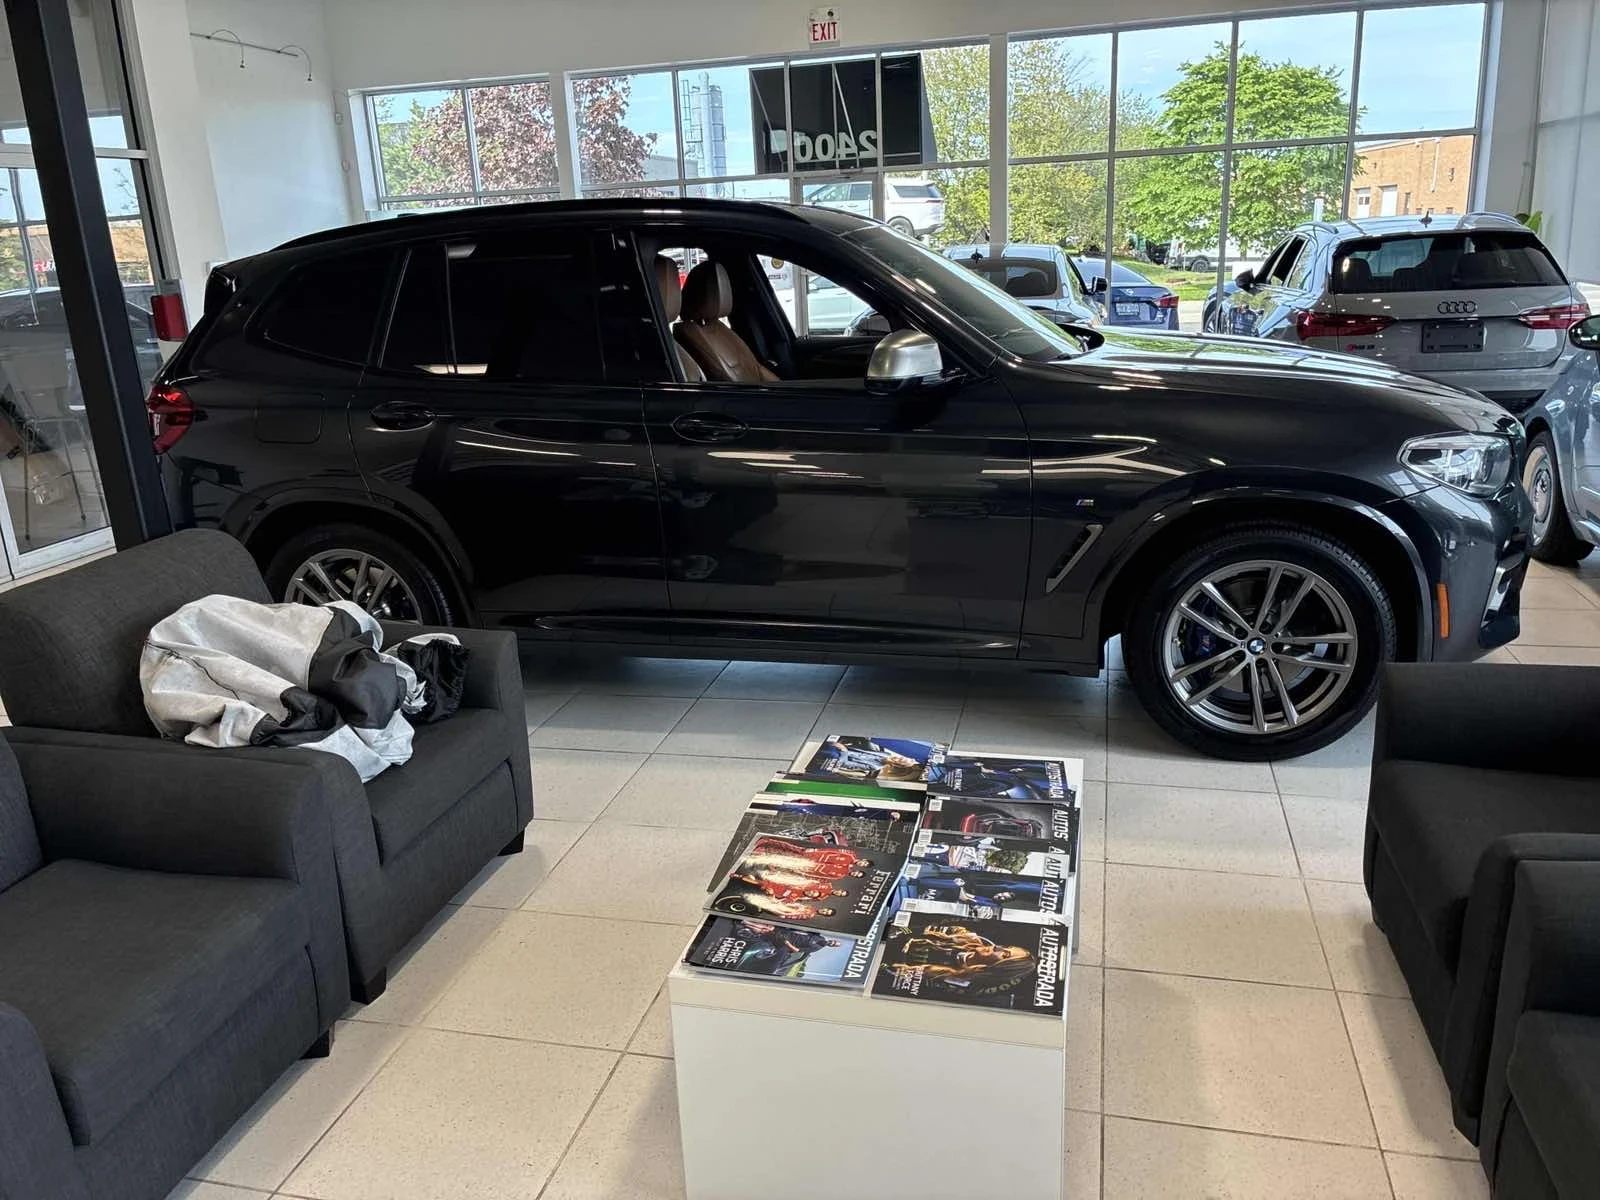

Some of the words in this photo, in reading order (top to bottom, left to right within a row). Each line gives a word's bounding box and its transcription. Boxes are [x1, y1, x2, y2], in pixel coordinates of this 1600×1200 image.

[812, 21, 837, 41] EXIT
[1053, 809, 1069, 842] AUTOS
[854, 869, 891, 915] Ferrari
[711, 937, 736, 964] HARRIS
[725, 940, 747, 964] CHRIS
[901, 970, 914, 991] FORCE
[910, 966, 925, 995] BRITTANY
[1034, 927, 1060, 1007] AUTOSTRADA
